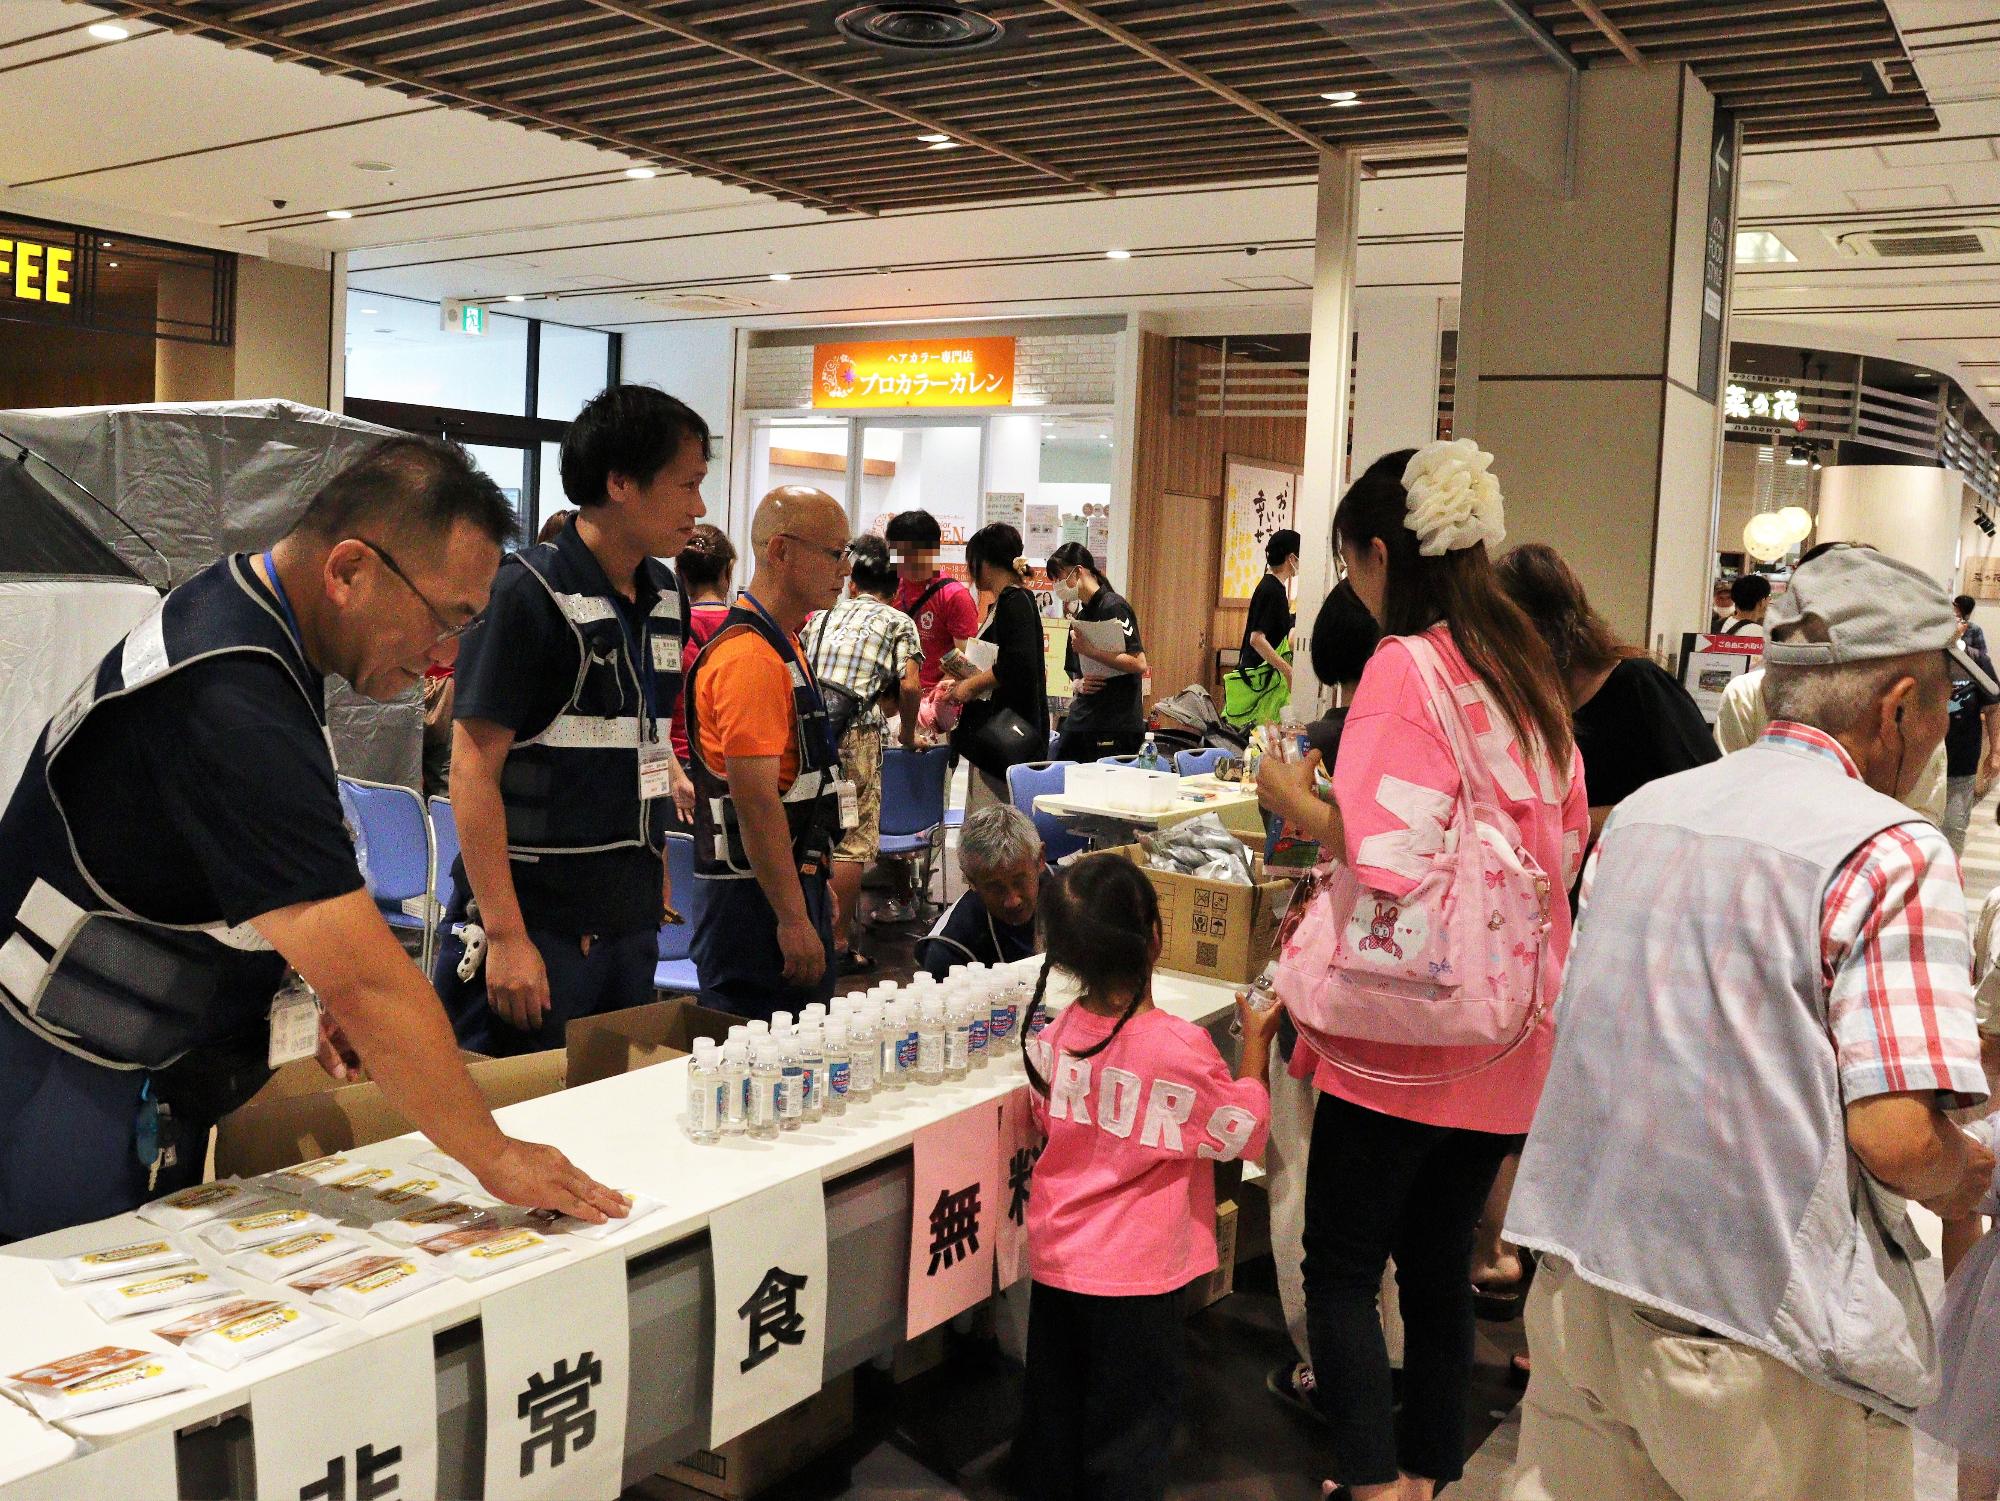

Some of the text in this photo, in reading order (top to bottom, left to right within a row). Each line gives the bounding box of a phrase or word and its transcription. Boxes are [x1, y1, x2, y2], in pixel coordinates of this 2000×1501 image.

[887, 350, 973, 364] ヘアカラー専門店
[860, 372, 1004, 396] プロカラーカレン
[1725, 384, 1800, 422] 菜の花
